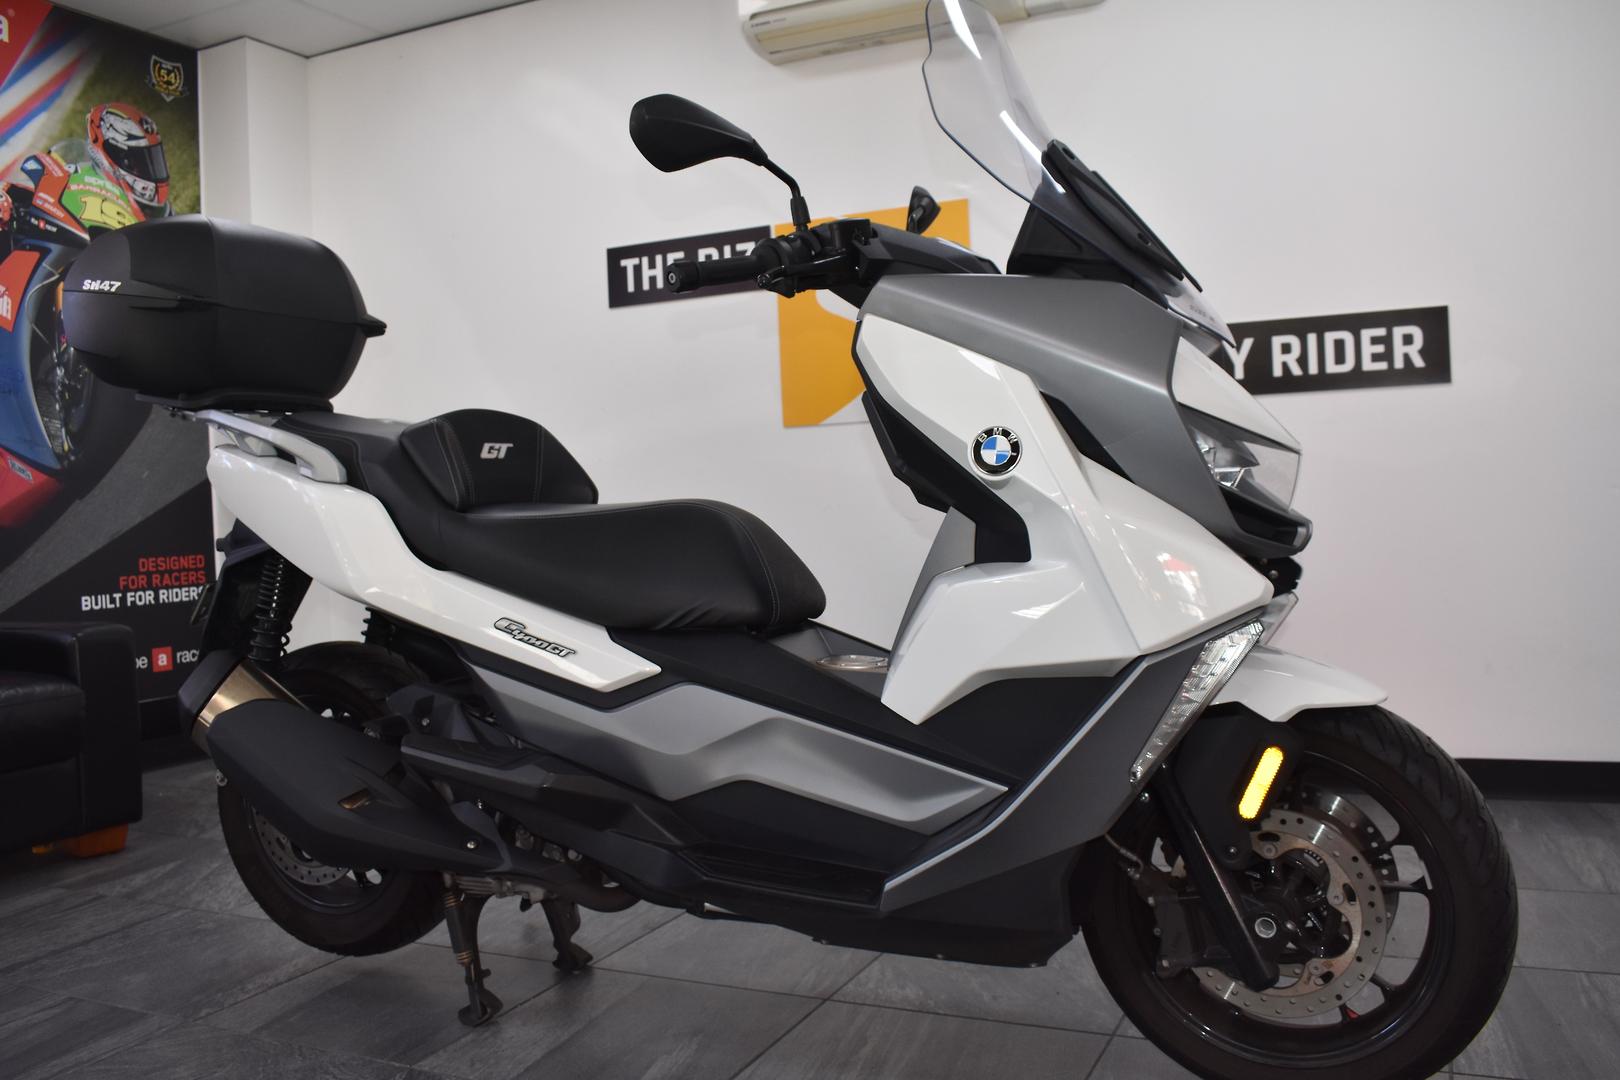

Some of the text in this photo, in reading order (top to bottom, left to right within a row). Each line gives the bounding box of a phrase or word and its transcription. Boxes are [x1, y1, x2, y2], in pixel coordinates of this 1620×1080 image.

[160, 69, 176, 84] 54
[1270, 325, 1426, 378] RIDER
[977, 427, 1018, 444] BMW
[480, 442, 514, 460] GT
[138, 554, 206, 572] DESIGNED
[119, 570, 207, 591] FOR RACERS
[81, 592, 122, 612] BUILT
[127, 590, 155, 607] FOR
[157, 653, 168, 667] a
[176, 648, 200, 664] rac
